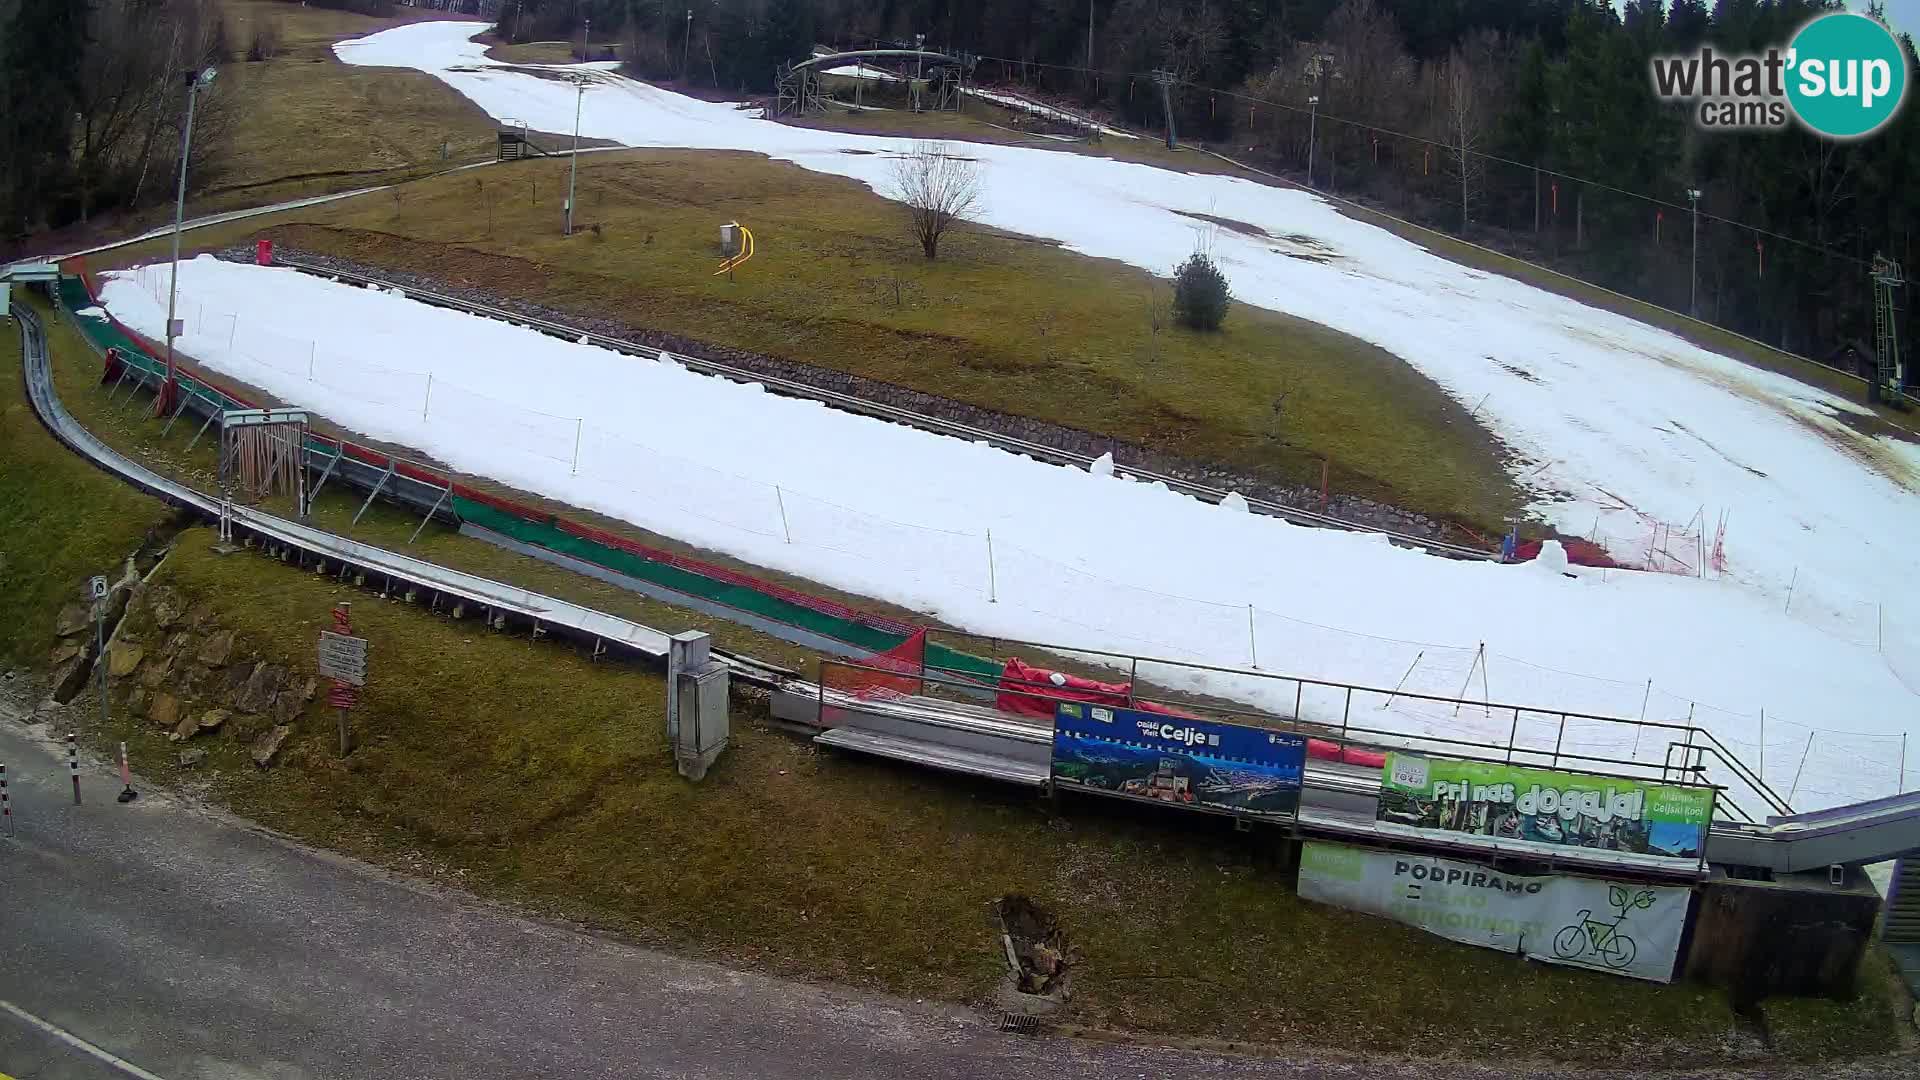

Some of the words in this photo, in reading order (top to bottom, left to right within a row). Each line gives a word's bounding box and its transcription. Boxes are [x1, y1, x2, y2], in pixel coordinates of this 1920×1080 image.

[1160, 724, 1206, 746] Celje
[1473, 783, 1515, 803] nas
[1394, 860, 1543, 894] PODPIRAMO
